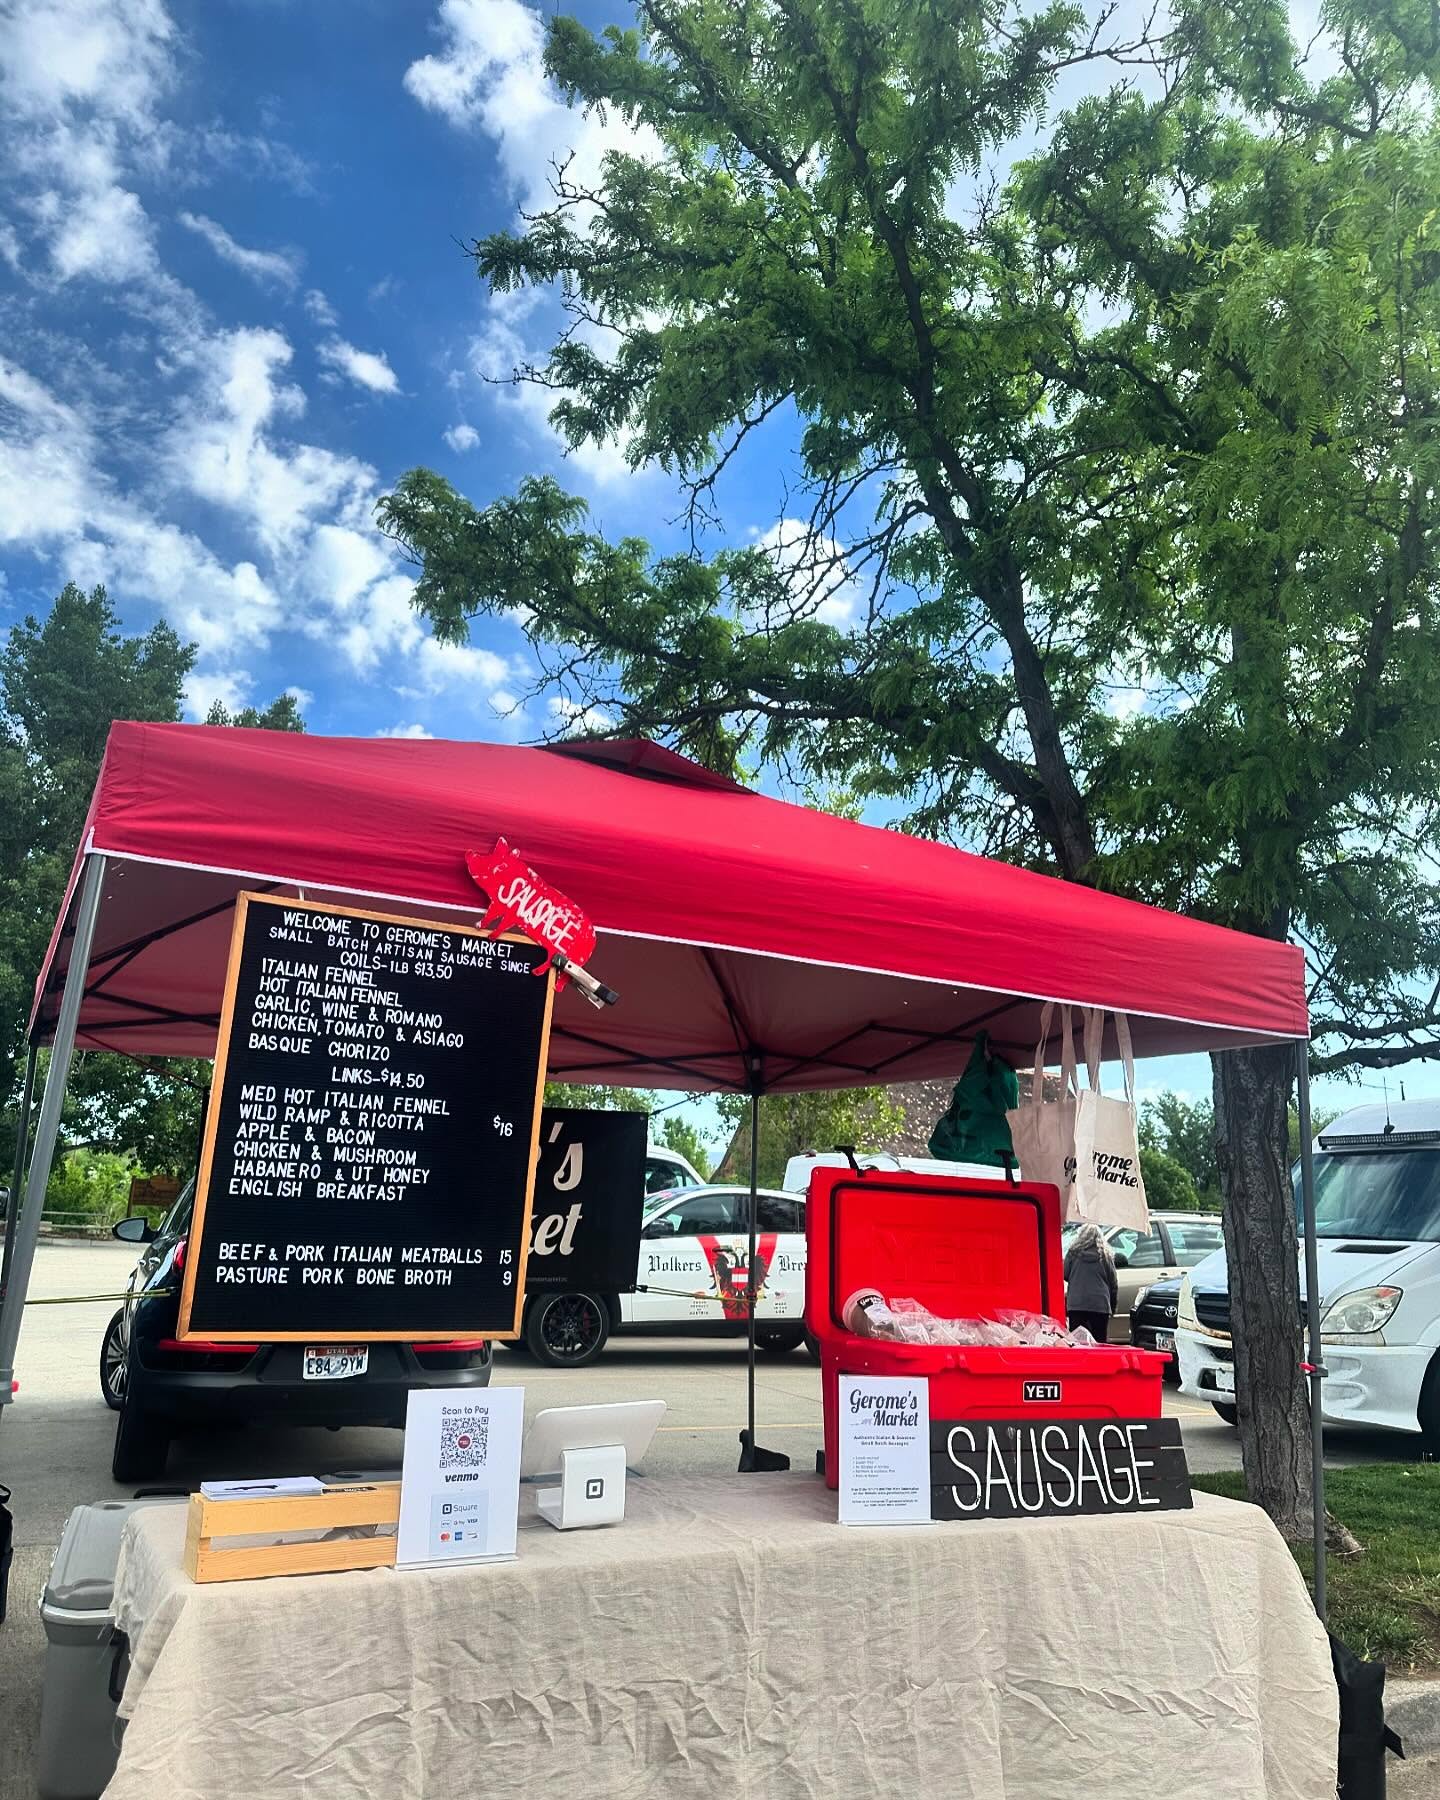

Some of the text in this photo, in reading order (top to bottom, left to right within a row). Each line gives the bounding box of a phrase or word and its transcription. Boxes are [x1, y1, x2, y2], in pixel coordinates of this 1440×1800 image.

[497, 877, 581, 954] SAUSAGE
[284, 912, 513, 958] WELCOME TO GEROME'S MARKET
[269, 927, 530, 974] SMALL BATCH ARTISAN SAUSAGE SINCE
[262, 958, 377, 987] ITALIAN FENNEL
[415, 962, 452, 979] $13.50
[260, 976, 403, 1007] HOT ITALIAN FENNEL
[322, 1002, 359, 1019] WINE
[369, 1007, 378, 1021] &
[385, 1008, 442, 1028] ROMANO
[249, 1033, 389, 1061] BASQUE CHORIZO
[396, 1027, 405, 1041] &
[413, 1030, 463, 1048] ASIAGO
[241, 1085, 450, 1115] MED HOT ITALIAN FENNEL
[240, 1104, 423, 1131] WILD RAMP & RICOTTA
[494, 1115, 513, 1136] $16
[236, 1122, 375, 1145] APPLE & BACON
[234, 1141, 416, 1165] CHICKEN & MUSHROOM
[234, 1160, 430, 1184] HABANERO & UT HONEY
[229, 1178, 406, 1201] ENGLISH BREAKFAST
[219, 1243, 512, 1264] BEEF & PORK ITALIAN MEATBALLS 15
[216, 1266, 289, 1284] PASTURE
[303, 1268, 344, 1284] PORK
[357, 1269, 396, 1285] BONE
[404, 1269, 452, 1285] BROTH
[503, 1271, 512, 1285] 9
[648, 1255, 702, 1277] Volkers
[778, 1255, 806, 1276] Bre
[307, 1357, 331, 1375] E84
[850, 1389, 918, 1413] Gerome's
[1026, 1385, 1058, 1398] YETI
[442, 1405, 489, 1415] Scan to Pay
[873, 1410, 918, 1426] Market
[445, 1473, 479, 1482] venmo
[947, 1424, 1161, 1512] SAUSAGE
[453, 1504, 478, 1513] Square
